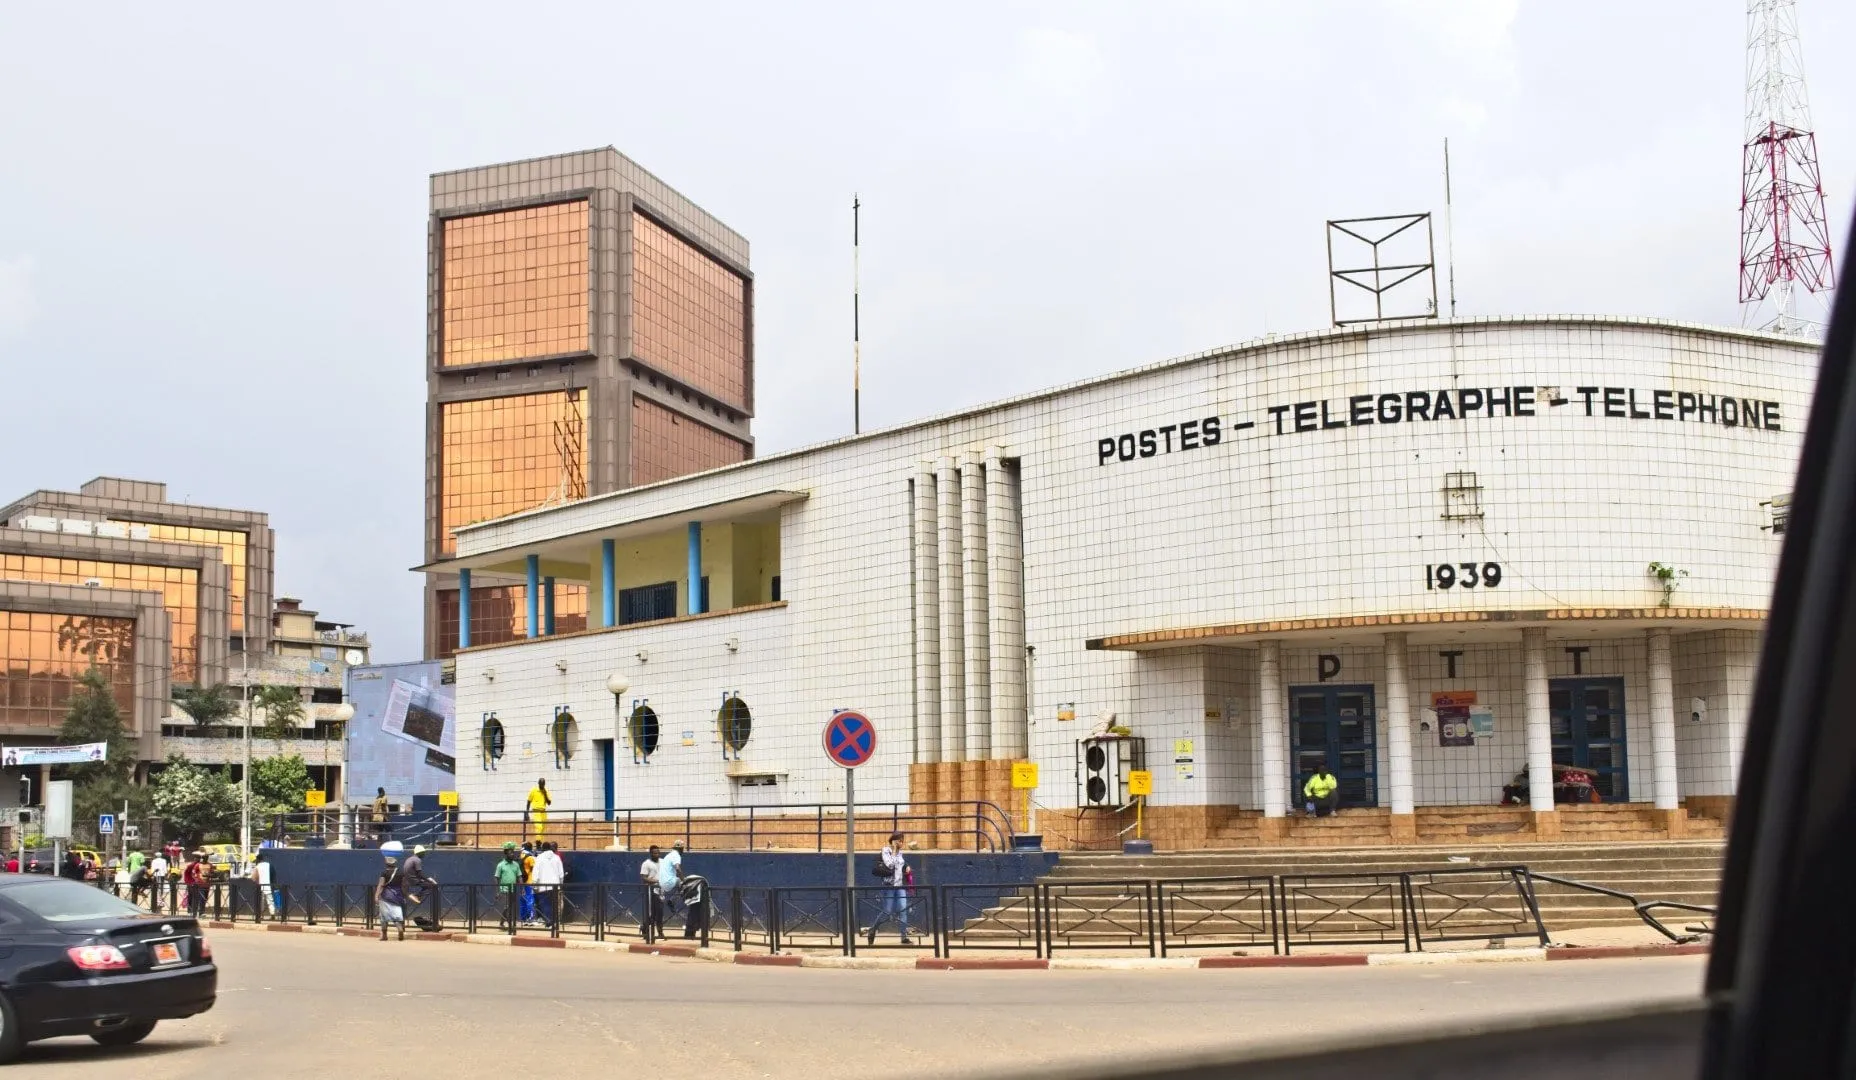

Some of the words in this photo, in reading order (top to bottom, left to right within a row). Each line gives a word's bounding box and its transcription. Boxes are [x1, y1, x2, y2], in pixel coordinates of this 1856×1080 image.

[1099, 417, 1221, 467] POSTES
[1268, 386, 1535, 436] TELEGRAPHE
[1577, 386, 1781, 432] TELEPHONE
[1426, 563, 1502, 590] 1939
[1317, 654, 1342, 683] P
[1439, 651, 1463, 678] T
[1565, 646, 1590, 675] T
